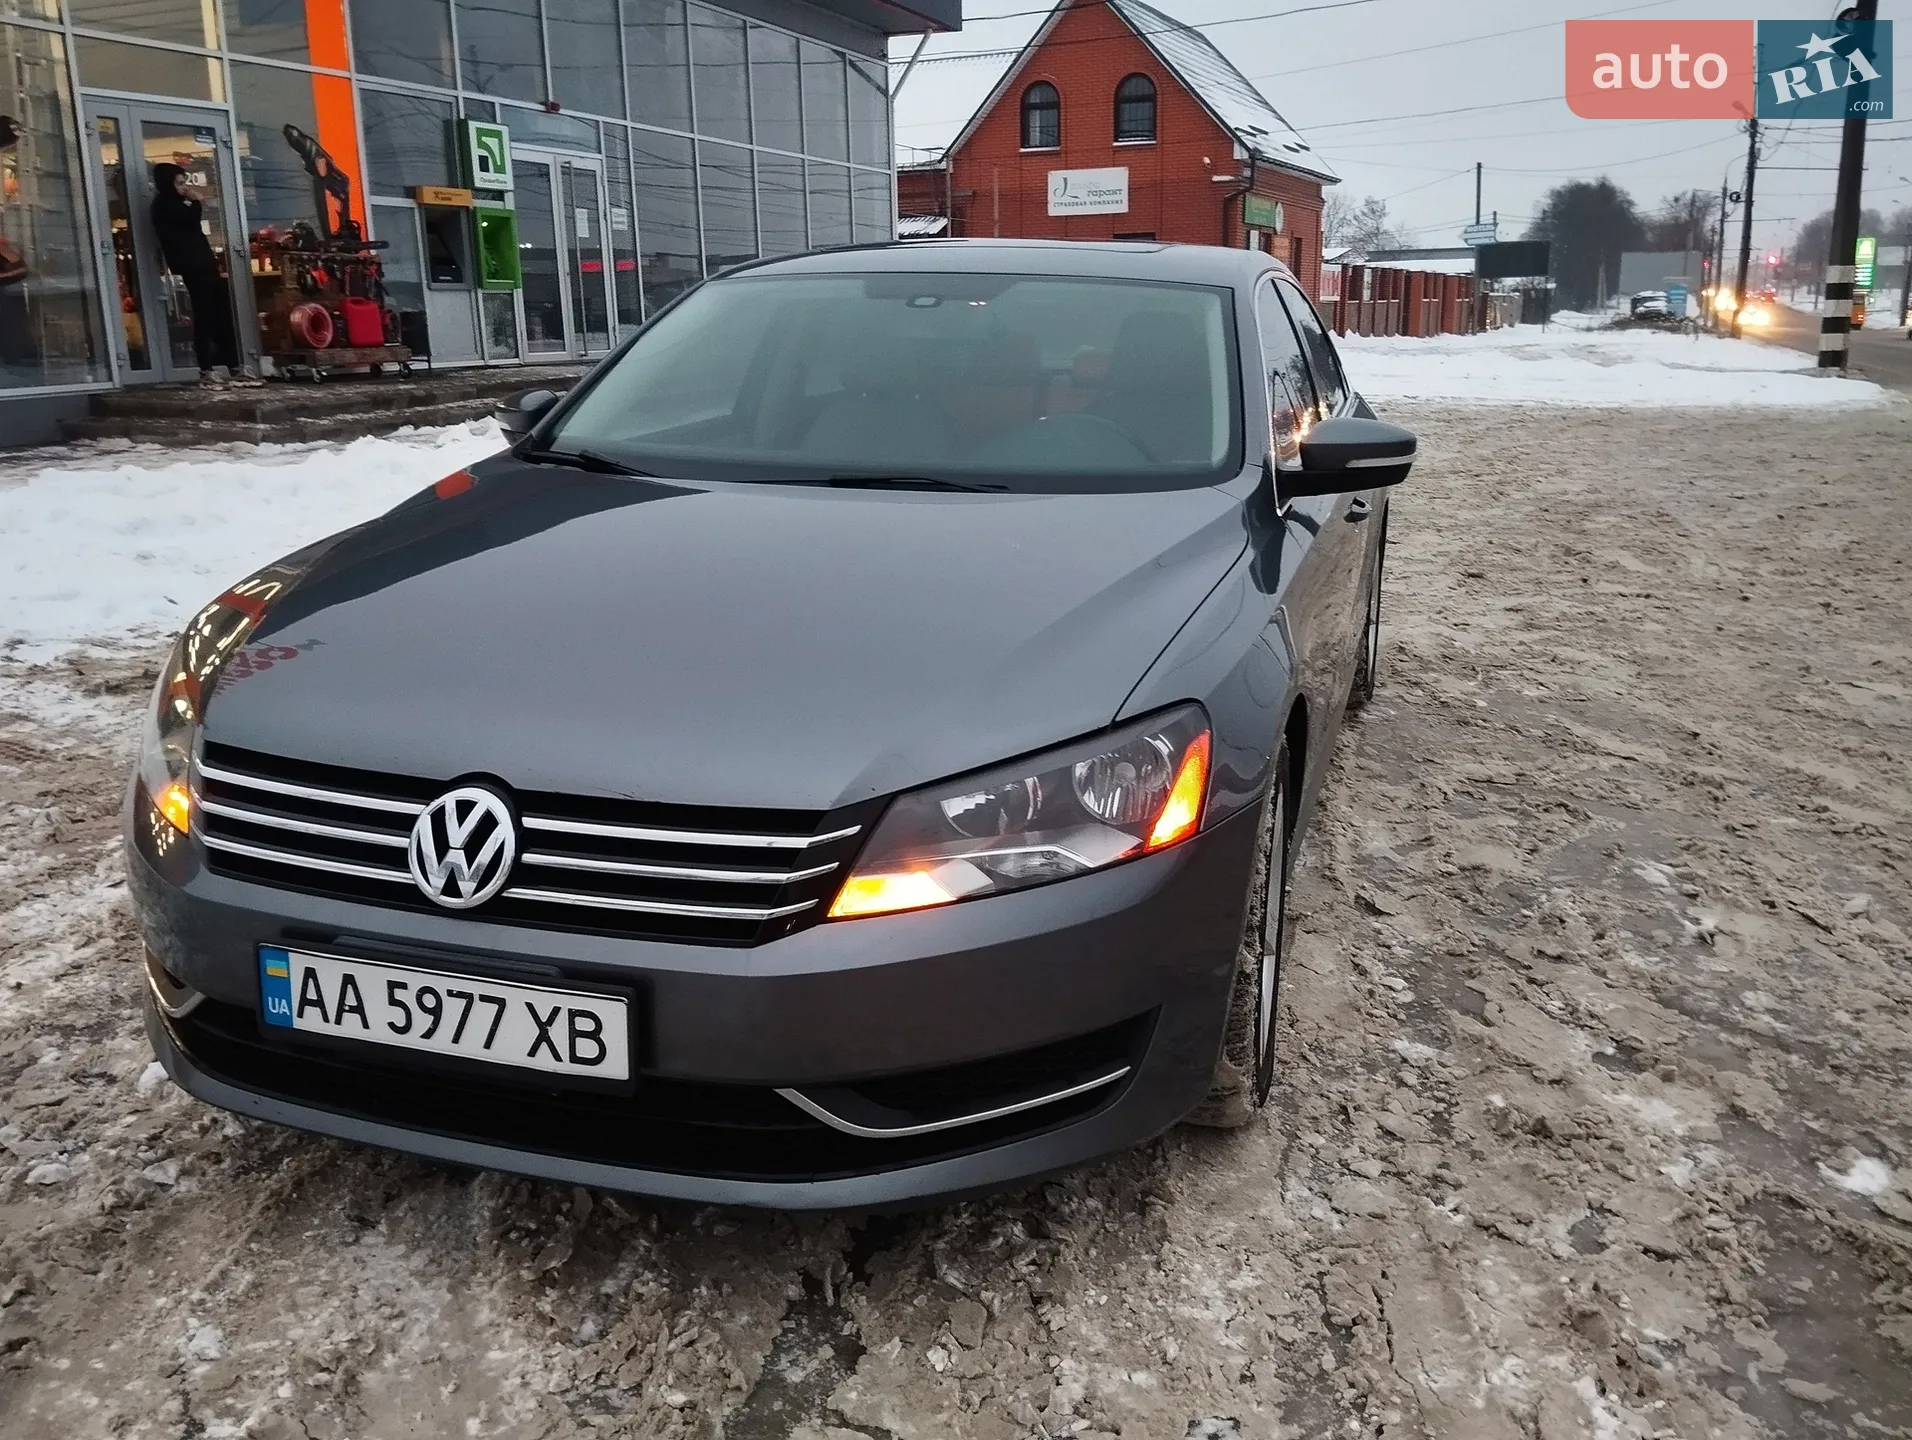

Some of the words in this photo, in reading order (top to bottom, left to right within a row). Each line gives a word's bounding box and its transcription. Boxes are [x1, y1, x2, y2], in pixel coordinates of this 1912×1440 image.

[268, 996, 290, 1016] UA
[296, 966, 370, 1030] AA
[386, 979, 507, 1050] 5977
[525, 1001, 607, 1067] XB
